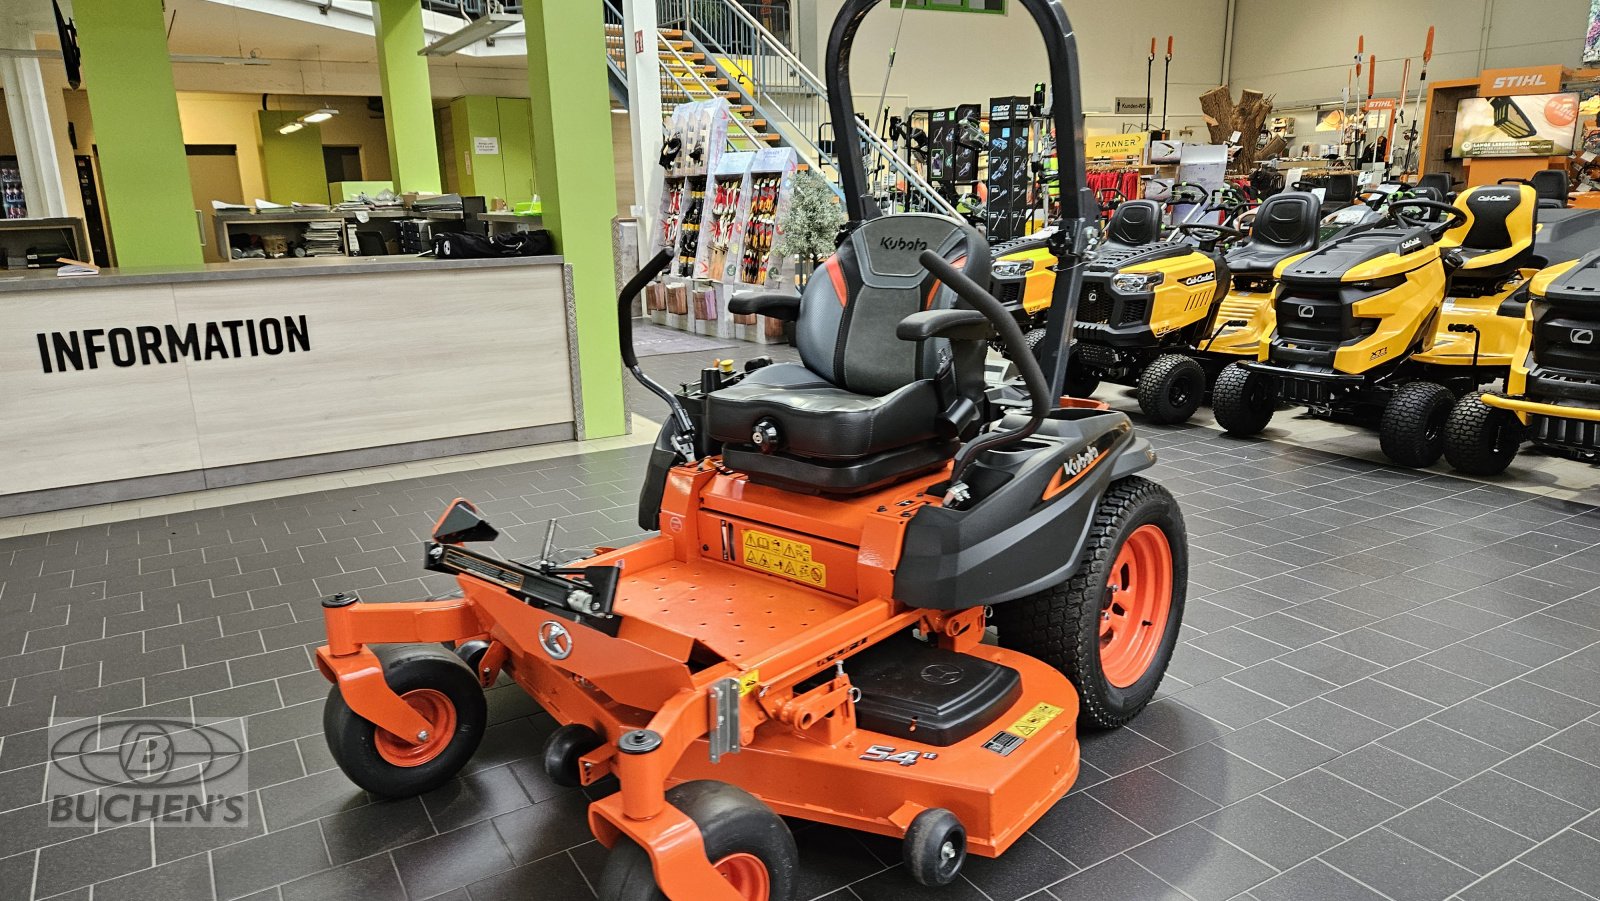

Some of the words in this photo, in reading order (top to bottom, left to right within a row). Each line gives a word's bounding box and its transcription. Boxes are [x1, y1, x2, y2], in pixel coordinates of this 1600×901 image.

[1493, 74, 1546, 89] STIHL
[992, 104, 1011, 112] EGO
[1095, 139, 1136, 148] PFANNER
[880, 236, 928, 250] Kubota
[37, 315, 311, 373] INFORMATION
[1063, 445, 1099, 476] Kubota
[859, 744, 938, 766] 54"
